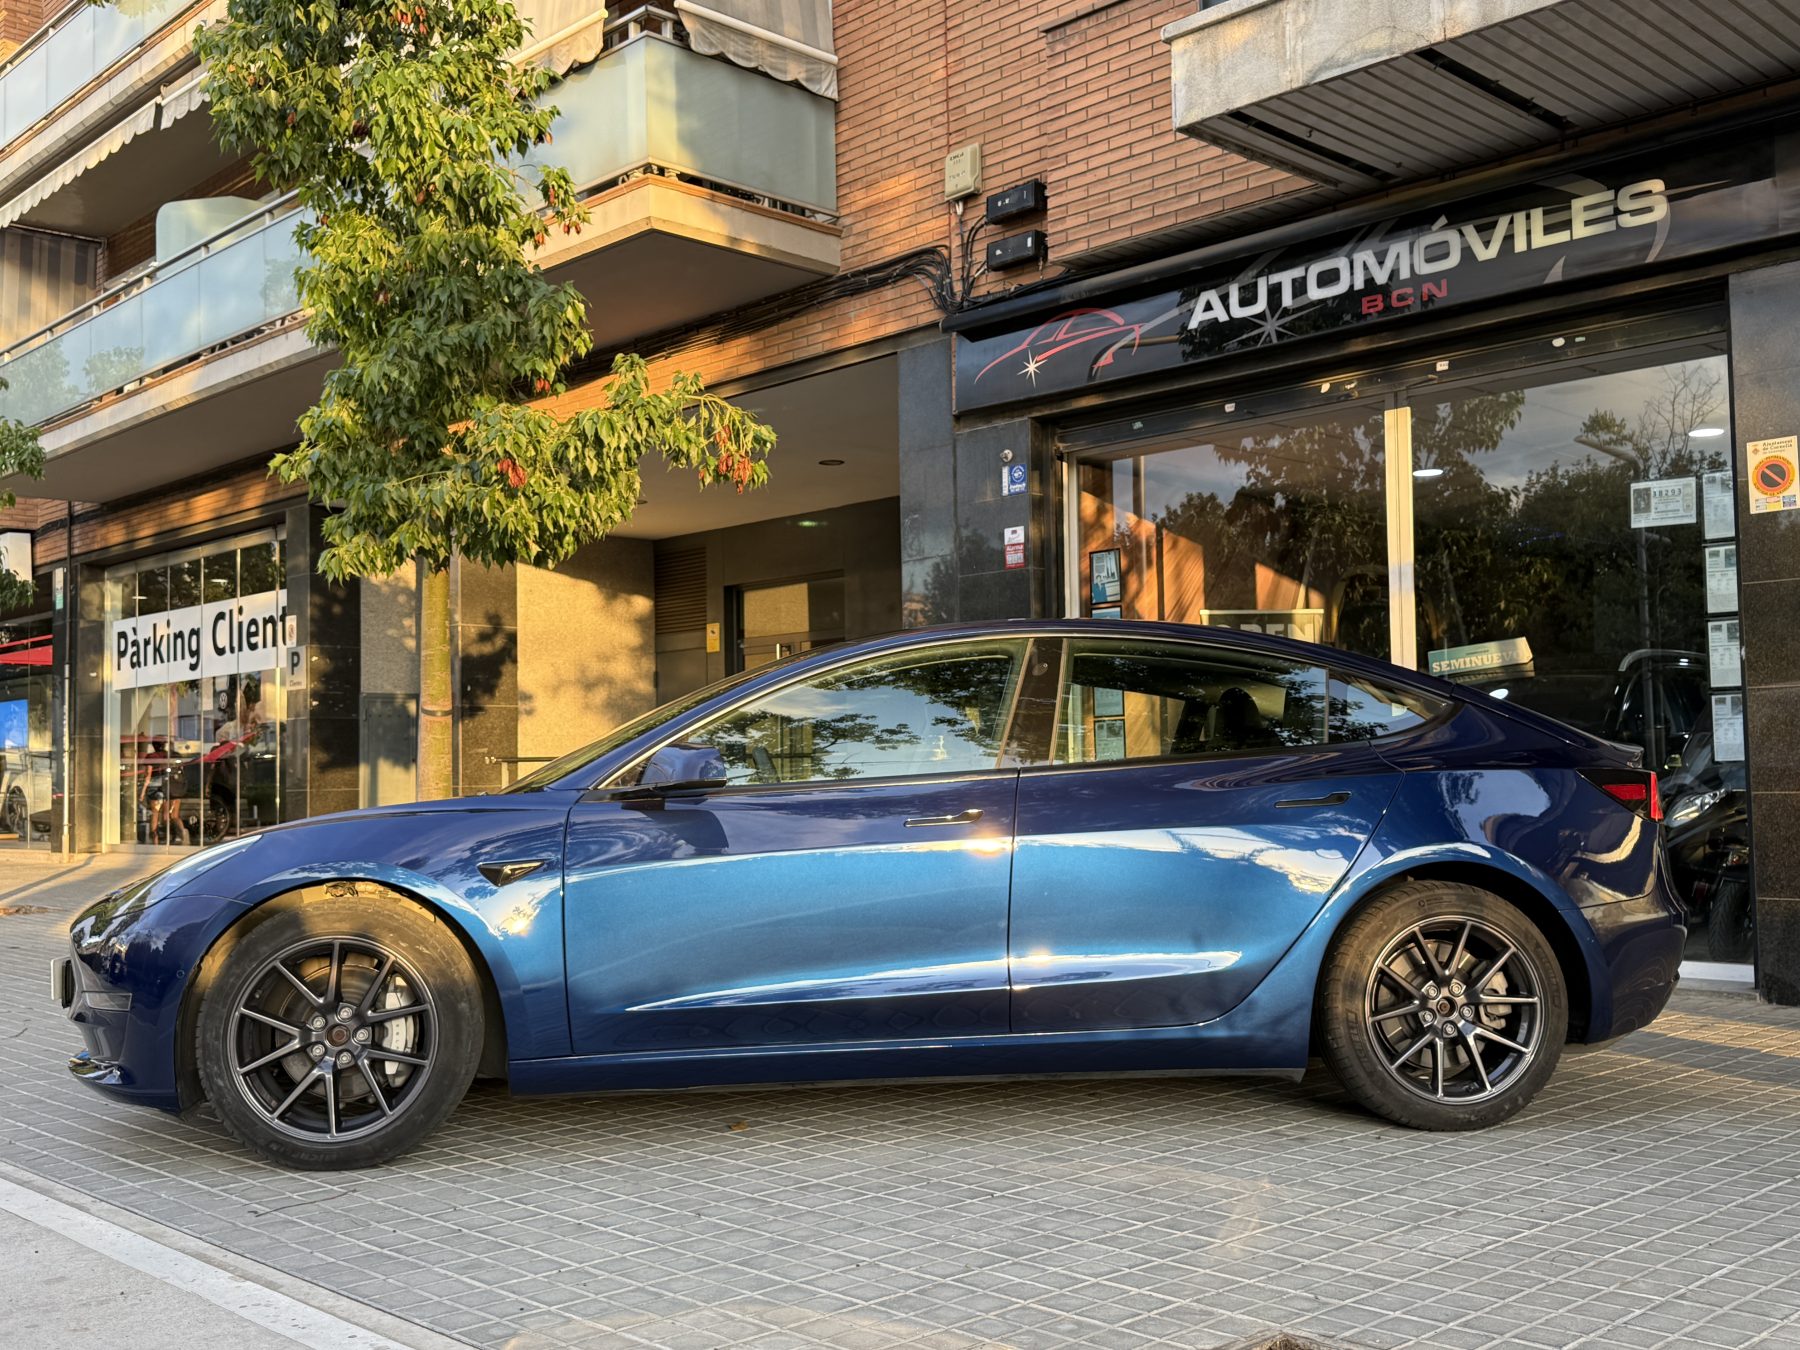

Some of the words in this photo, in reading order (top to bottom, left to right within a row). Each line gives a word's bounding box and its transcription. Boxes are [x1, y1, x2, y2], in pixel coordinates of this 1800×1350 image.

[1187, 178, 1668, 330] AUTOMÓVILES
[1361, 278, 1448, 315] BCN
[117, 618, 201, 672] Pàrking
